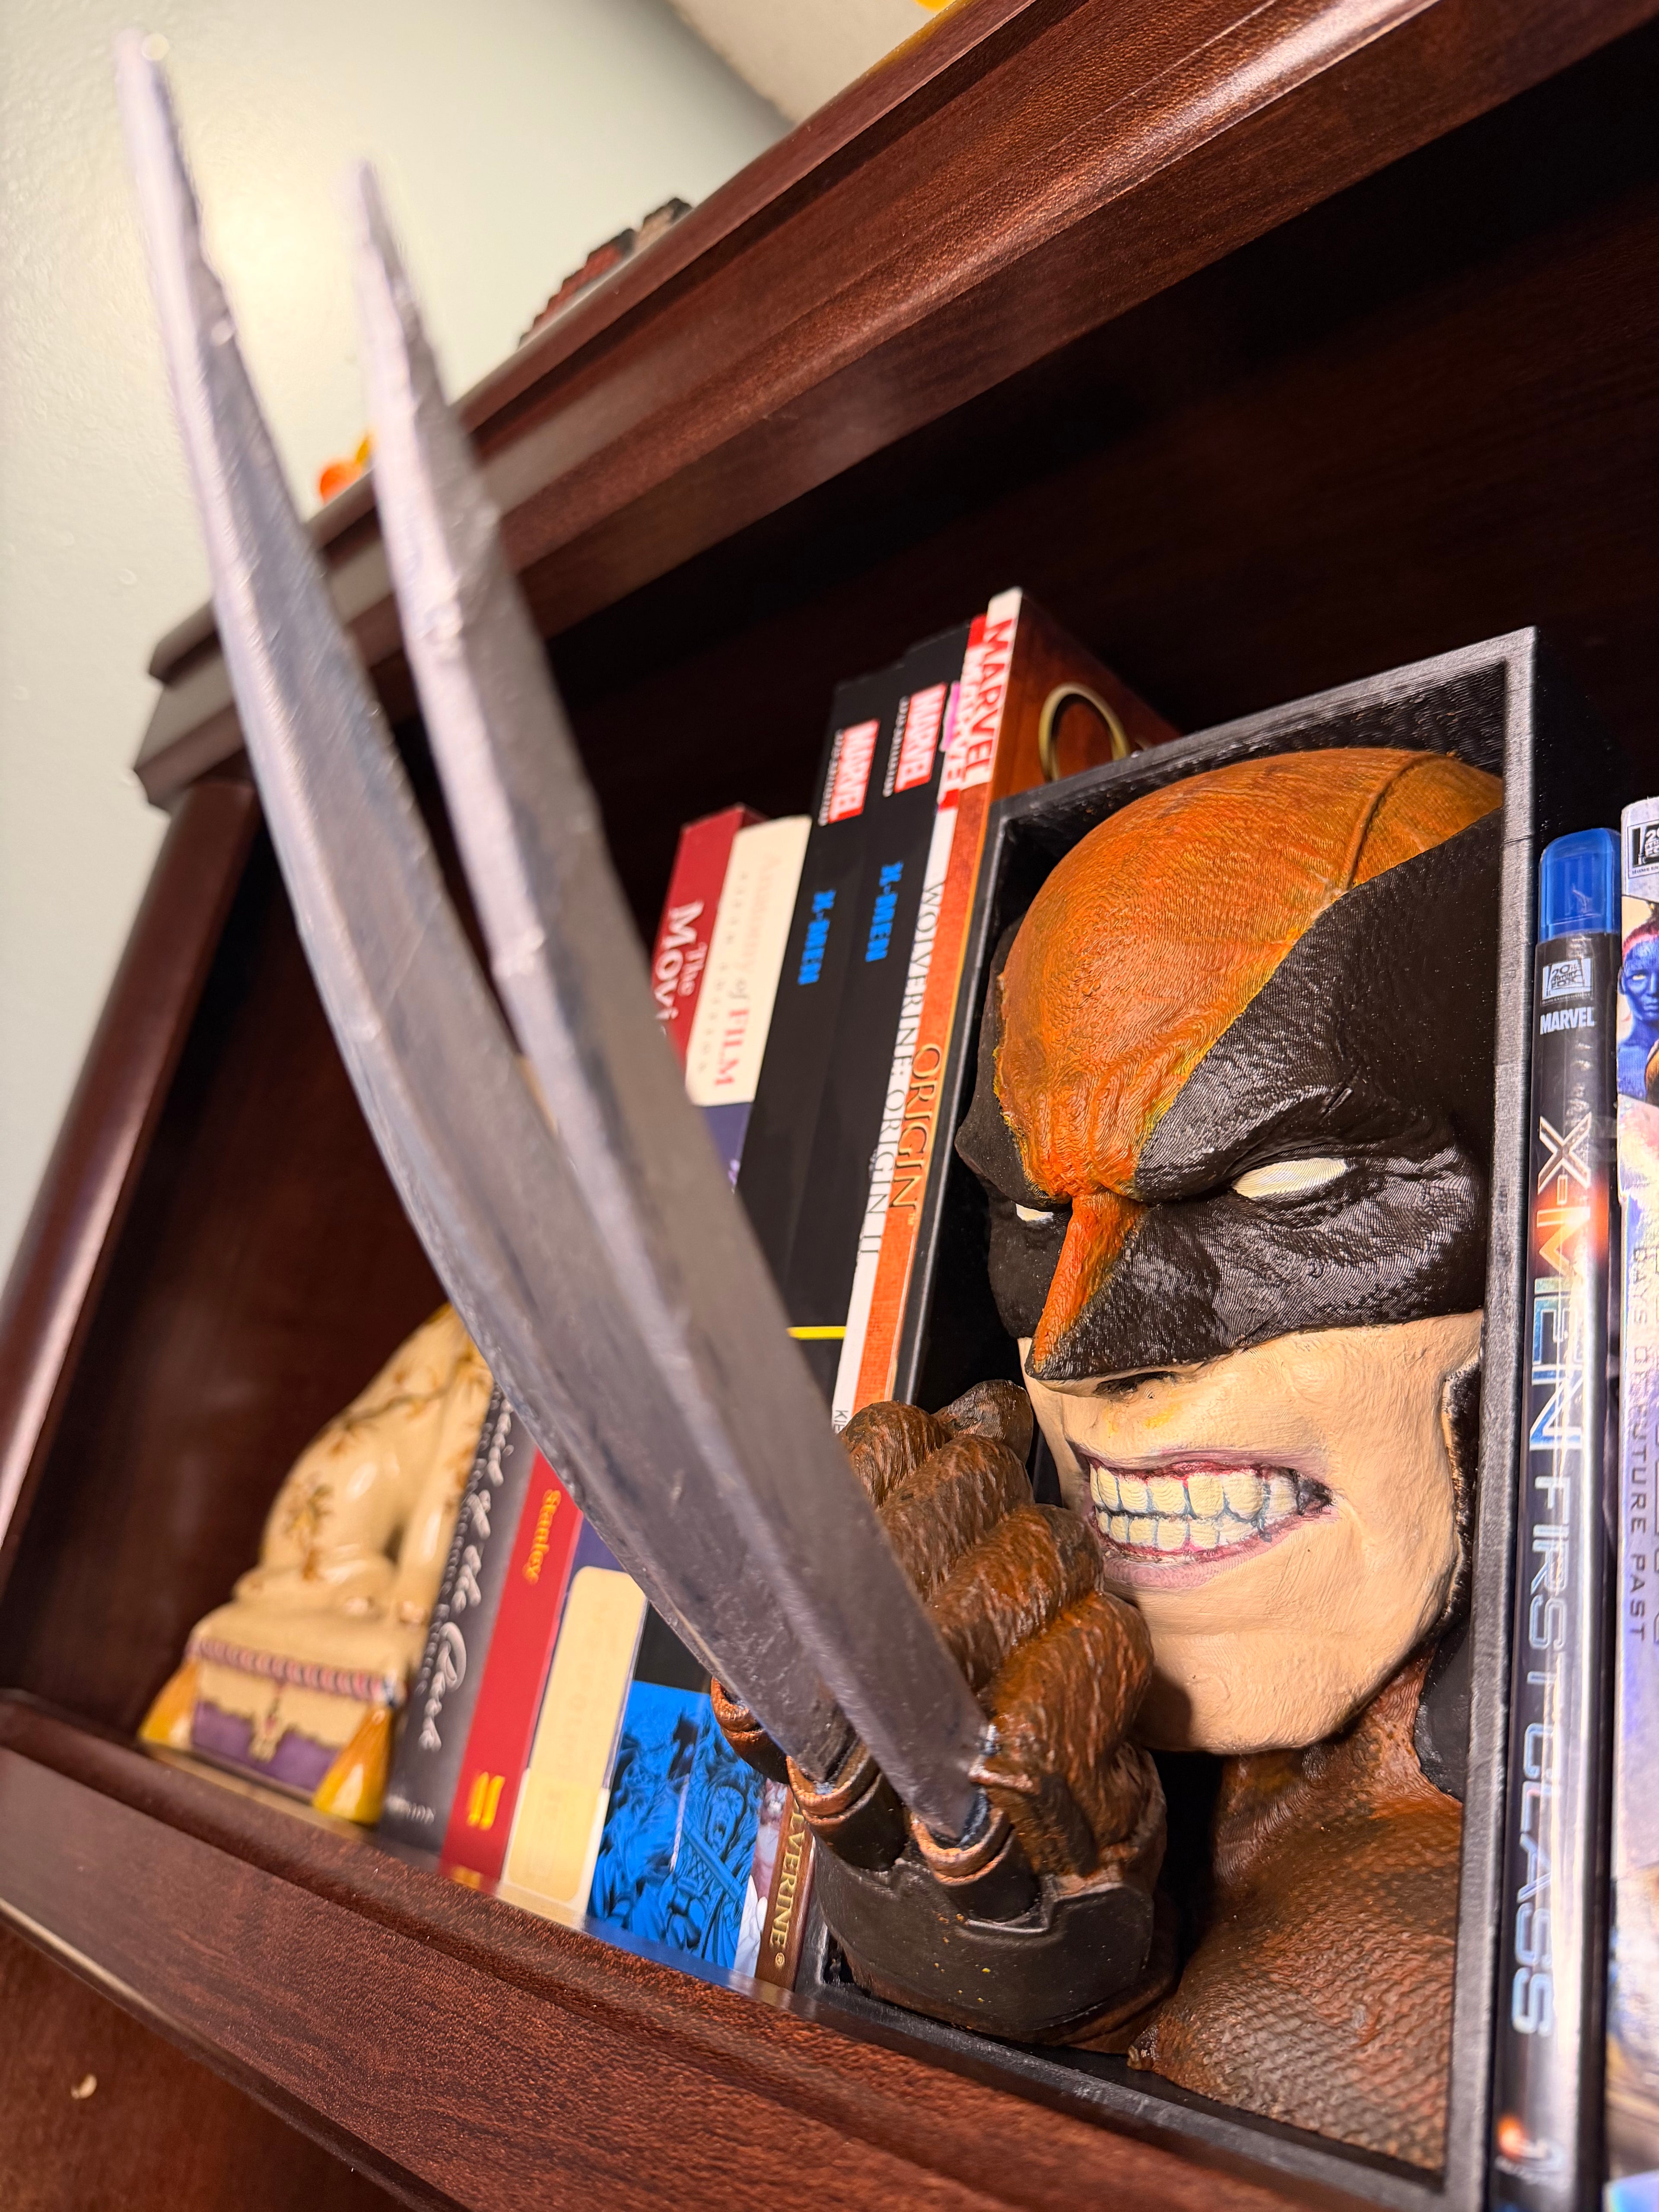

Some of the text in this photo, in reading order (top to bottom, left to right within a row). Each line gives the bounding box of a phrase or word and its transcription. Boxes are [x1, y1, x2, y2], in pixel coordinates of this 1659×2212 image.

[896, 683, 947, 791] MARVEL
[965, 619, 1014, 772] MARVEL
[830, 719, 879, 822] MARVEL
[798, 888, 836, 985] X-MEN
[865, 861, 904, 963] X-MEN
[654, 900, 705, 1033] Movi
[677, 941, 708, 996] The
[715, 1008, 750, 1086] FILM
[1540, 1006, 1595, 1035] MARVEL
[865, 1089, 905, 1216] ORIGIN
[889, 1043, 942, 1211] ORIGIN
[521, 1489, 561, 1585] Stanley
[1629, 1554, 1647, 1641] PAST
[769, 1799, 804, 1948] LVERINE
